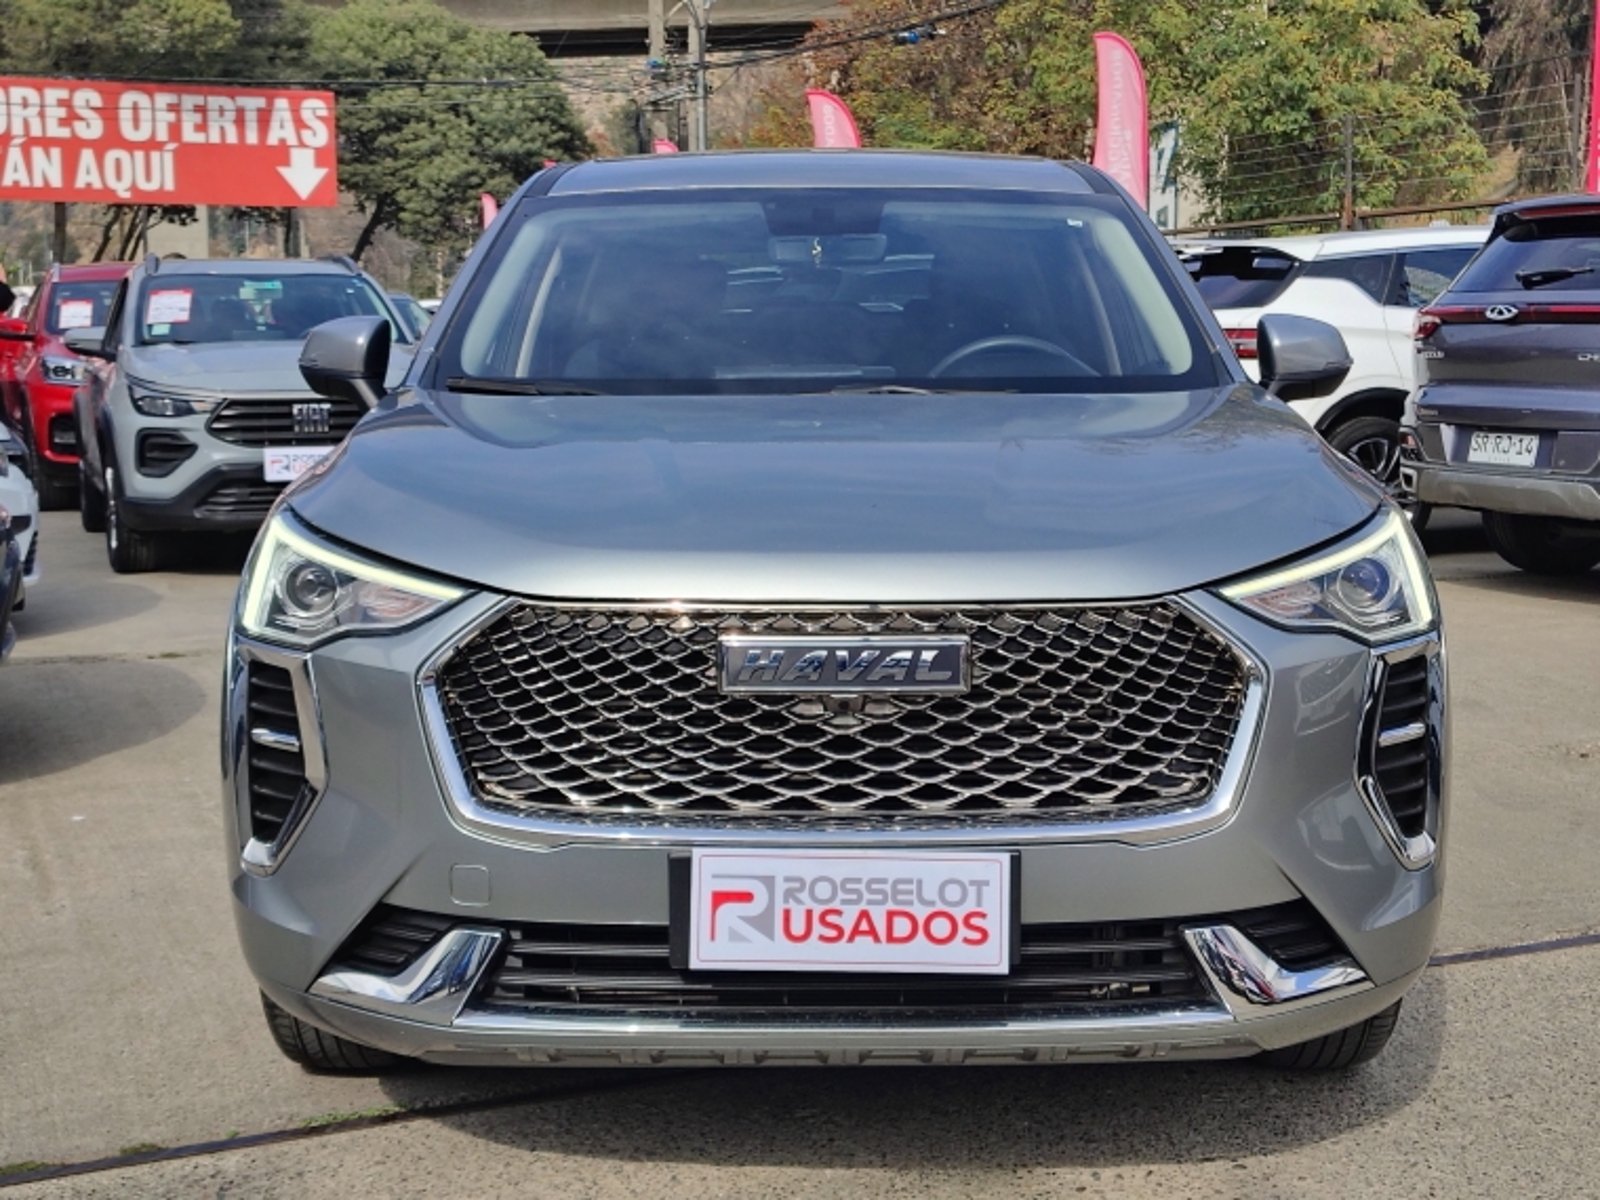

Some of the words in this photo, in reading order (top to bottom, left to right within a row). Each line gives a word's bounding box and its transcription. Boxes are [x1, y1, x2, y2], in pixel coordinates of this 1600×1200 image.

[0, 86, 104, 140] RES
[118, 90, 329, 148] OFERTAS
[0, 136, 63, 188] ÁN
[74, 143, 179, 198] AQUÍ
[738, 650, 952, 681] HAVAL
[782, 875, 990, 908] ROSSELOT
[782, 908, 990, 946] USADOS
